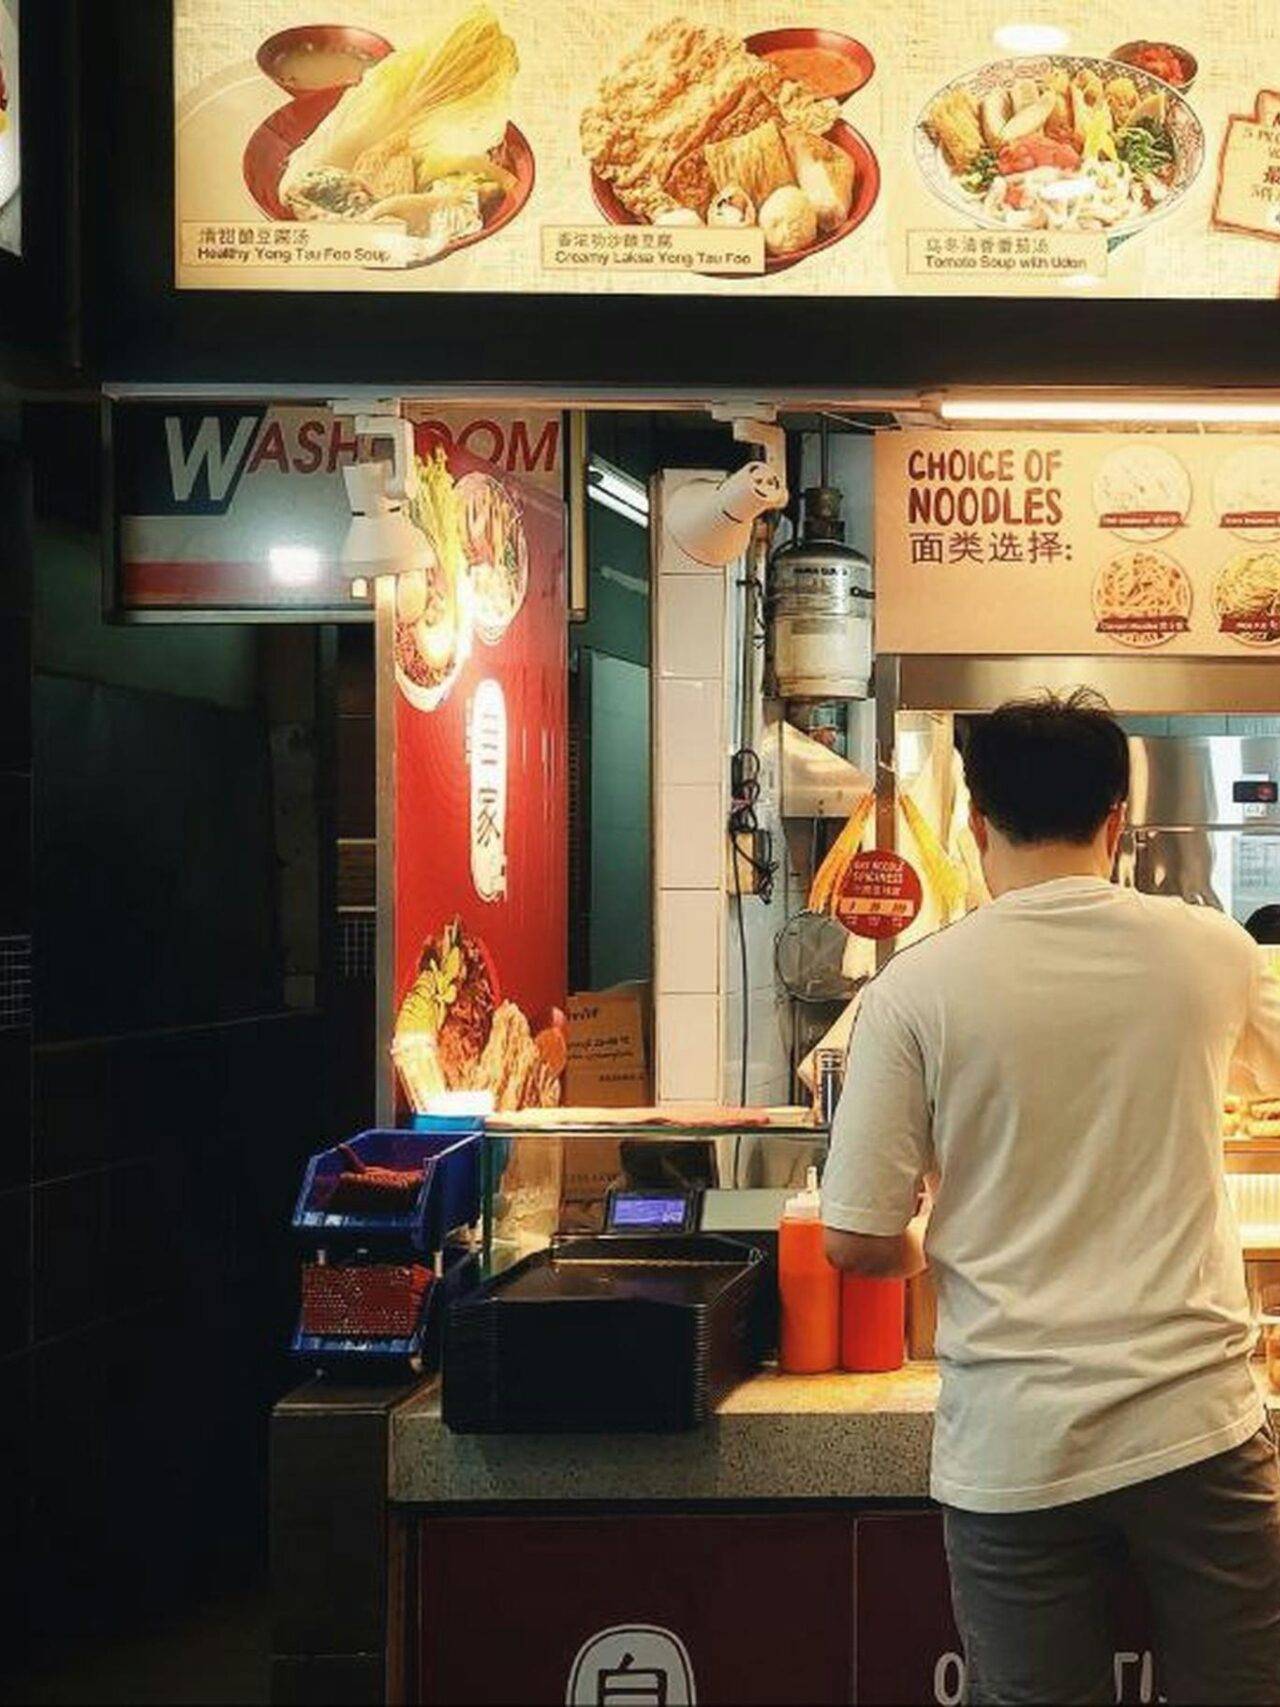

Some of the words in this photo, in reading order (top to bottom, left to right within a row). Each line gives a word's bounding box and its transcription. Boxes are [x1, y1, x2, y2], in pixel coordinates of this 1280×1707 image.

[198, 248, 250, 263] Healthy
[255, 248, 292, 263] Yong
[297, 248, 321, 260] Tau
[324, 249, 351, 261] Foo
[355, 248, 391, 263] Soup
[555, 250, 609, 266] Creamy
[613, 251, 654, 264] Laksa
[659, 252, 693, 267] Yong
[699, 252, 723, 264] Tau
[727, 253, 751, 265] Foo
[926, 255, 977, 268] Tomato
[980, 255, 1016, 270] Soup
[1020, 255, 1048, 269] with
[1052, 256, 1087, 269] Udon
[908, 448, 1014, 482] CHOICE
[1024, 448, 1063, 482] OF
[908, 487, 1063, 526] NOODLES
[909, 531, 1073, 564] 面类选择:
